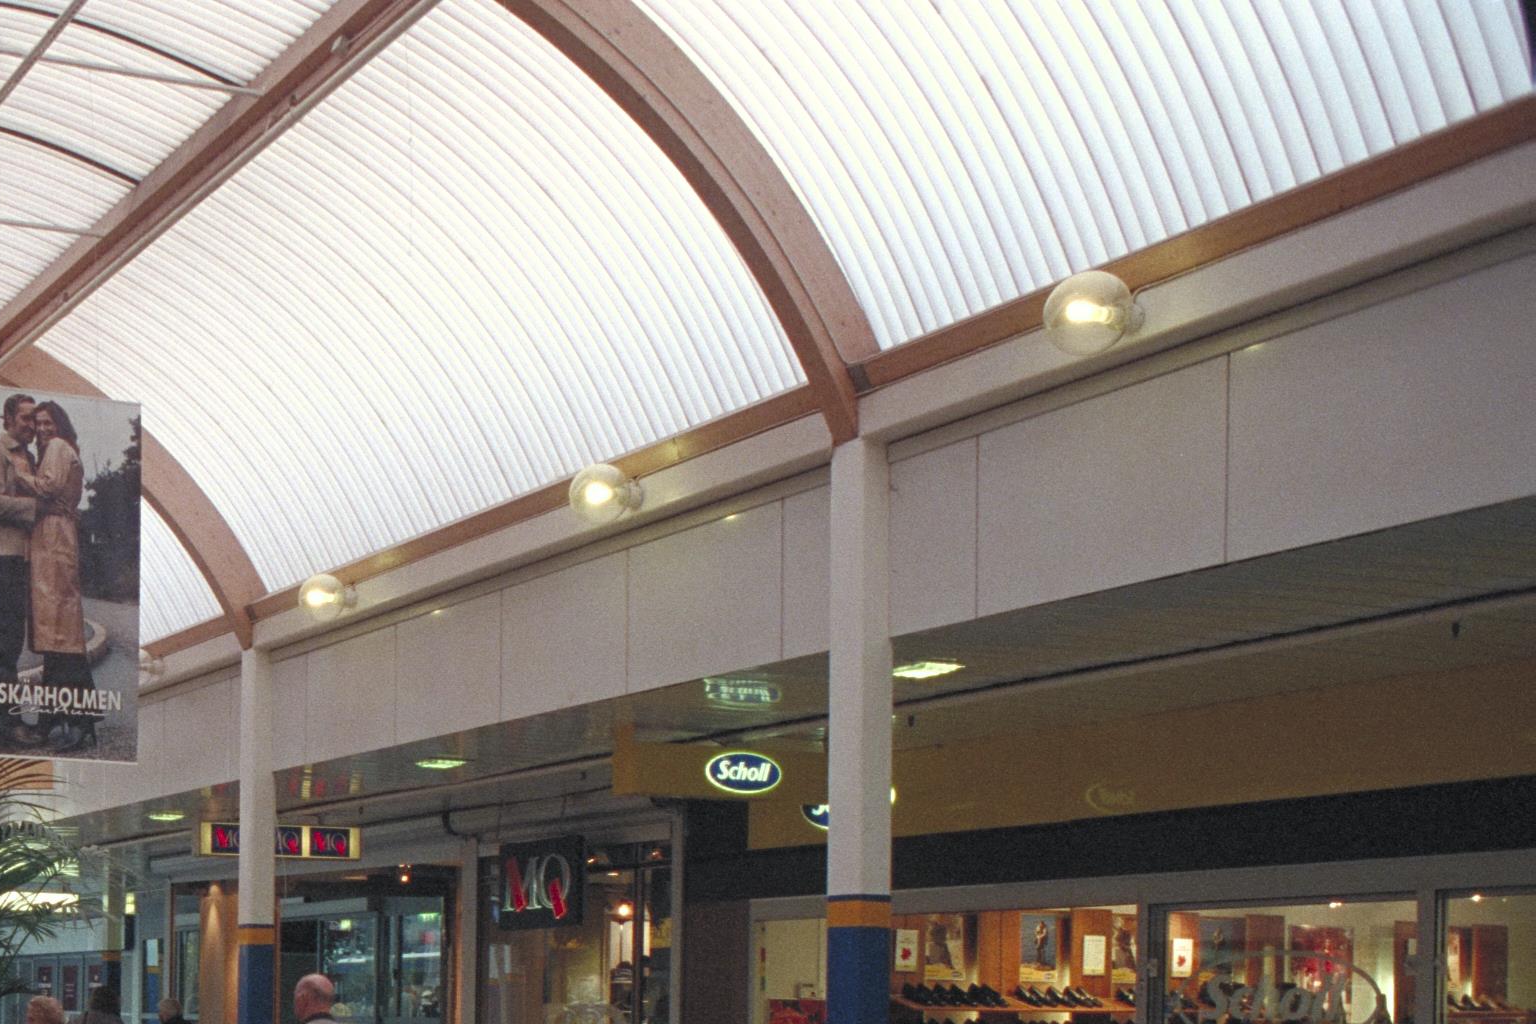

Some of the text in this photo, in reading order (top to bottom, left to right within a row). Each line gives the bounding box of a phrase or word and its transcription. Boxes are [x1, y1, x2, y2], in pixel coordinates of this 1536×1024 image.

[717, 759, 772, 782] Scholl
[314, 831, 347, 856] MQ
[502, 853, 571, 919] MQ
